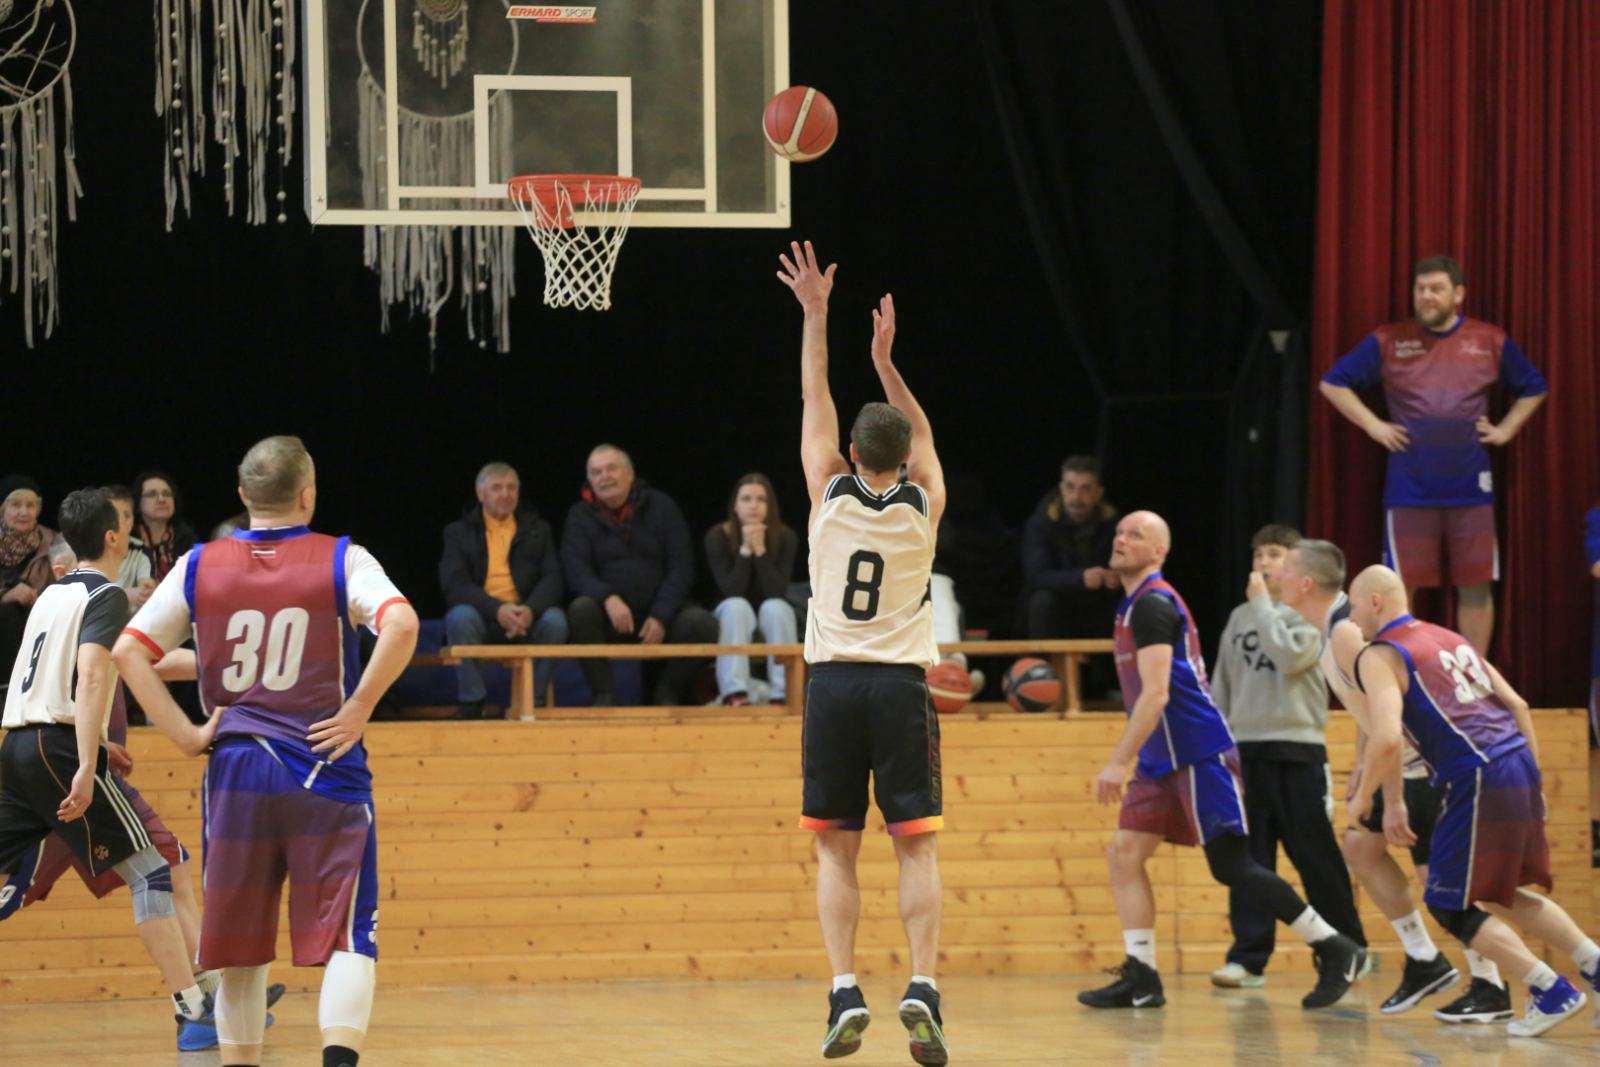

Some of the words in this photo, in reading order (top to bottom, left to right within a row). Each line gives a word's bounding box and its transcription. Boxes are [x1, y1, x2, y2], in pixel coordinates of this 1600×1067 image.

[509, 8, 562, 17] ERHARD
[565, 8, 592, 18] SPORT
[842, 549, 885, 621] 8
[21, 631, 47, 694] 9
[222, 607, 309, 692] 30
[1439, 644, 1493, 704] 33
